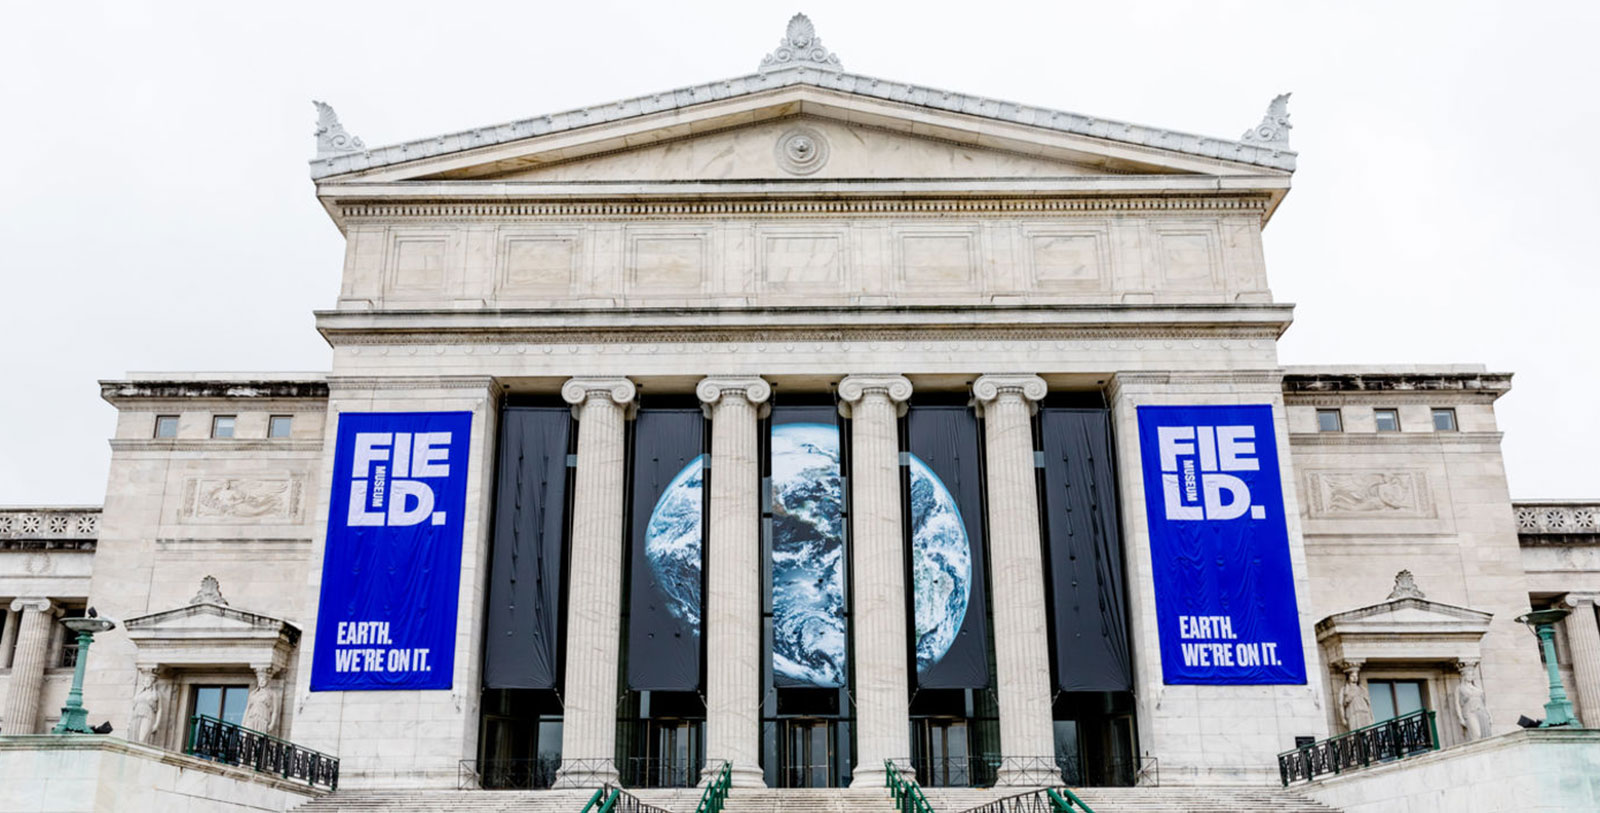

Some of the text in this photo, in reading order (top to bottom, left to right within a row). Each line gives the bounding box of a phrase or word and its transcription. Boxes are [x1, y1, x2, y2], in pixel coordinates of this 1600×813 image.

[372, 465, 387, 508] MUSEUM
[1183, 459, 1198, 502] MUSEUM
[336, 621, 393, 645] EARTH.
[1179, 615, 1238, 640] EARTH.
[335, 648, 431, 673] WE'RE ON IT.
[1181, 642, 1282, 667] WE'RE ON IT.
